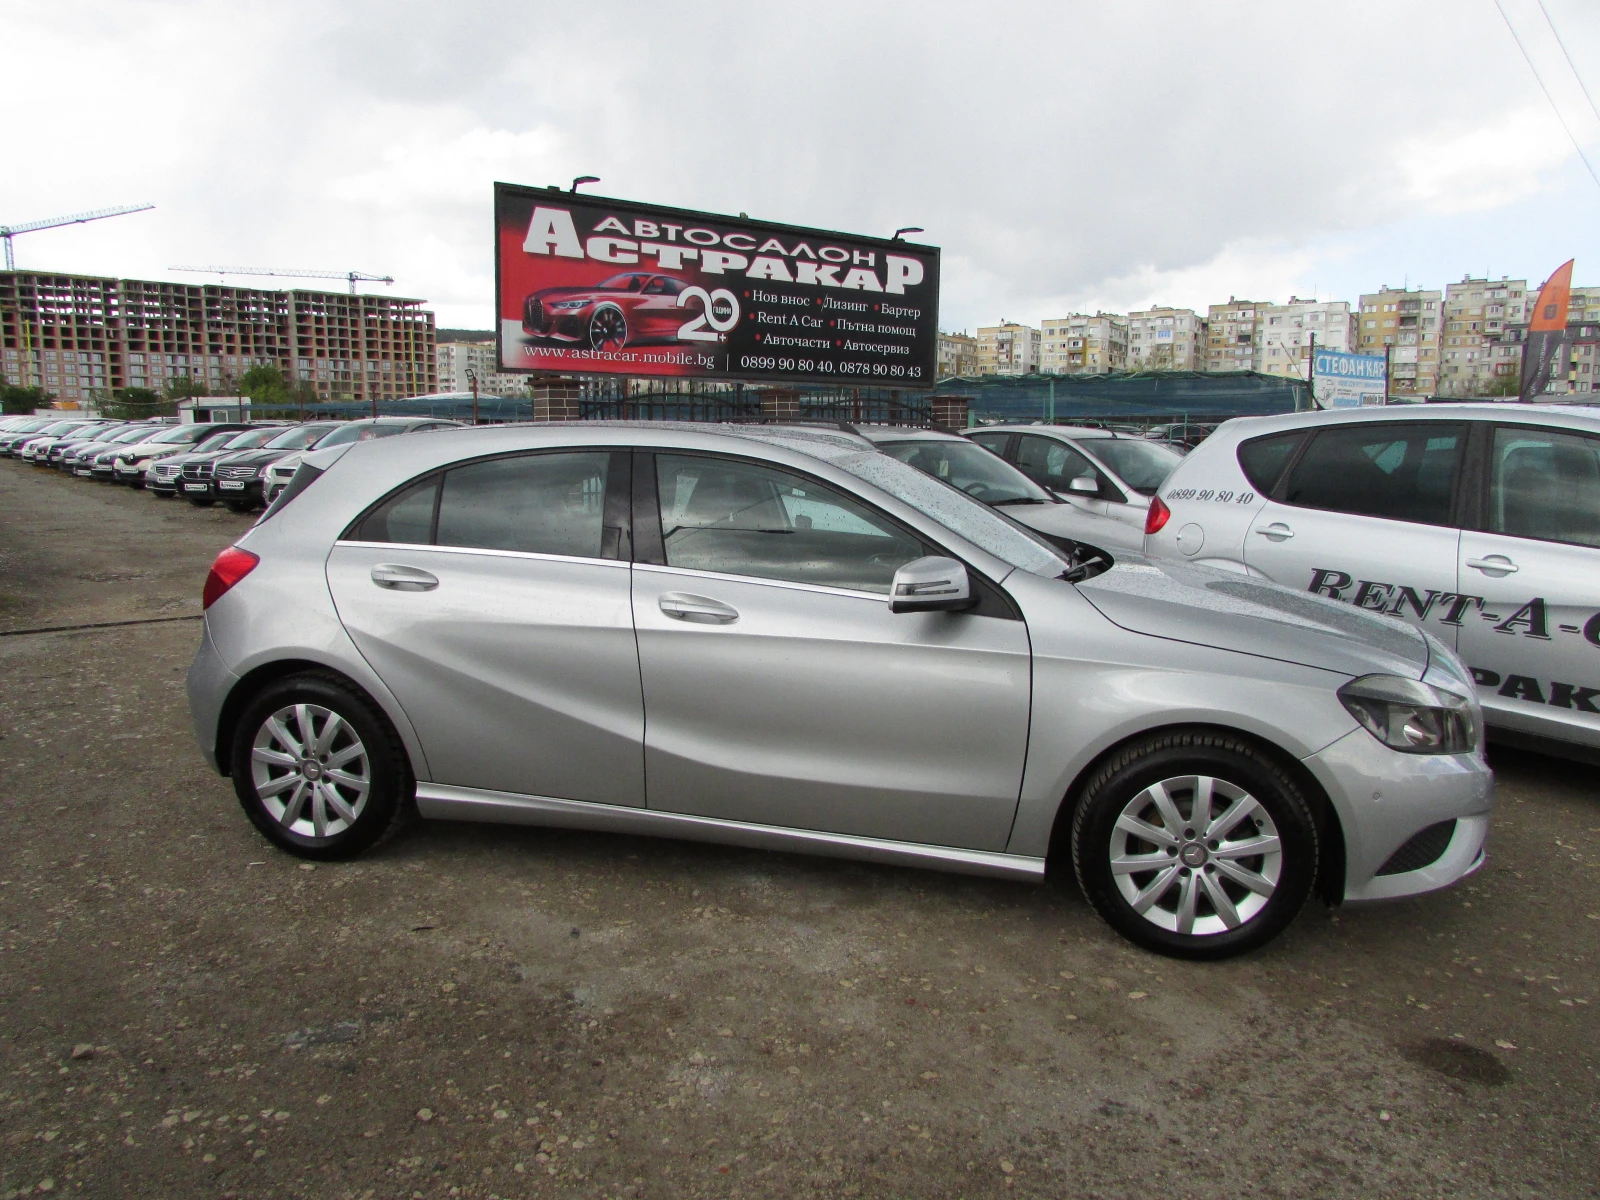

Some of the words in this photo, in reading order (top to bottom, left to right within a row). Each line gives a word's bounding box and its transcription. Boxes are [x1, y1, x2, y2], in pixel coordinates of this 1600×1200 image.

[522, 206, 925, 295] АСТРАКАР
[592, 216, 876, 267] АВТОСАЛОН
[752, 289, 778, 304] Нов
[780, 295, 811, 307] внос
[822, 297, 869, 312] Лизинг
[757, 311, 788, 325] Rent
[788, 314, 799, 326] A
[801, 315, 824, 328] Car
[881, 303, 921, 320] Бартер
[836, 318, 876, 333] Пътна
[877, 326, 917, 338] помощ
[763, 332, 831, 349] Авточасти
[843, 339, 910, 356] Автосервиз
[523, 345, 715, 369] www.astracar.mobile.bg
[1315, 355, 1365, 377] СТЕФАН
[740, 355, 776, 370] 0899
[778, 357, 795, 371] 90
[797, 359, 814, 372] 80
[839, 361, 870, 375] 0878
[872, 363, 888, 376] 90
[889, 364, 905, 377] 80
[906, 366, 922, 378] 43
[1166, 488, 1197, 500] 0899
[1196, 489, 1215, 501] 90
[1215, 490, 1234, 503] 80
[1236, 492, 1254, 505] 40
